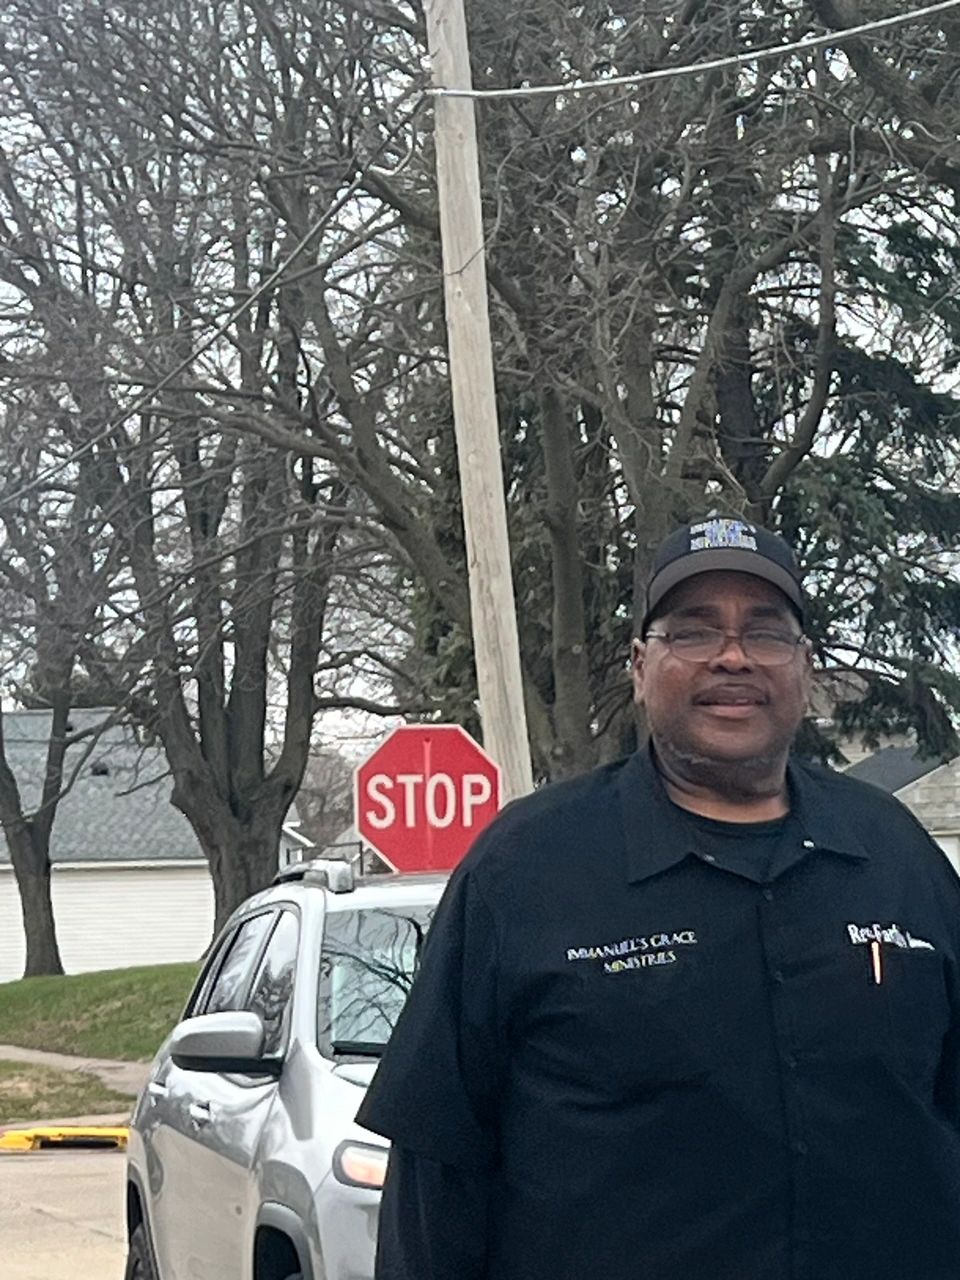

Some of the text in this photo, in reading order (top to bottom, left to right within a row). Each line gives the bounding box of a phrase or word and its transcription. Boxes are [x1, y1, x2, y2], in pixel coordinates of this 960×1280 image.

[366, 762, 492, 829] STOP
[649, 931, 697, 948] GRACE
[603, 950, 677, 973] MINISTRIES
